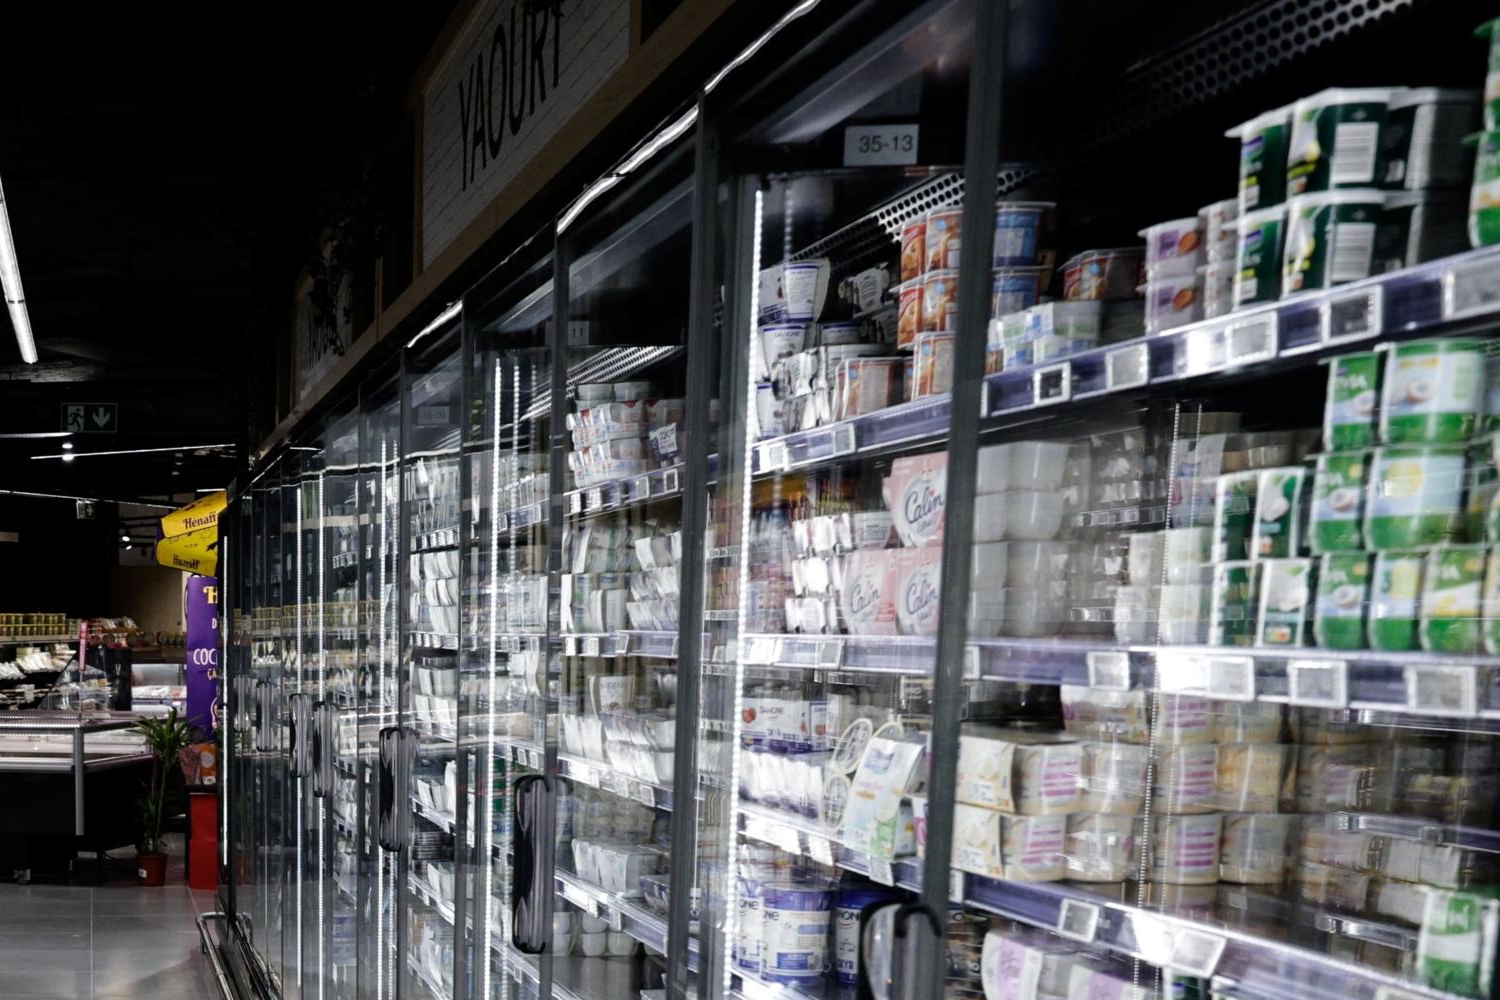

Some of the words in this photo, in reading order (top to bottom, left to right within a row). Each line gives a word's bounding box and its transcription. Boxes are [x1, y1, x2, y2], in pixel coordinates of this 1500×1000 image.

[459, 0, 566, 191] YAOURT
[859, 135, 913, 153] 35-13
[904, 486, 945, 525] Calin
[193, 648, 218, 666] COC
